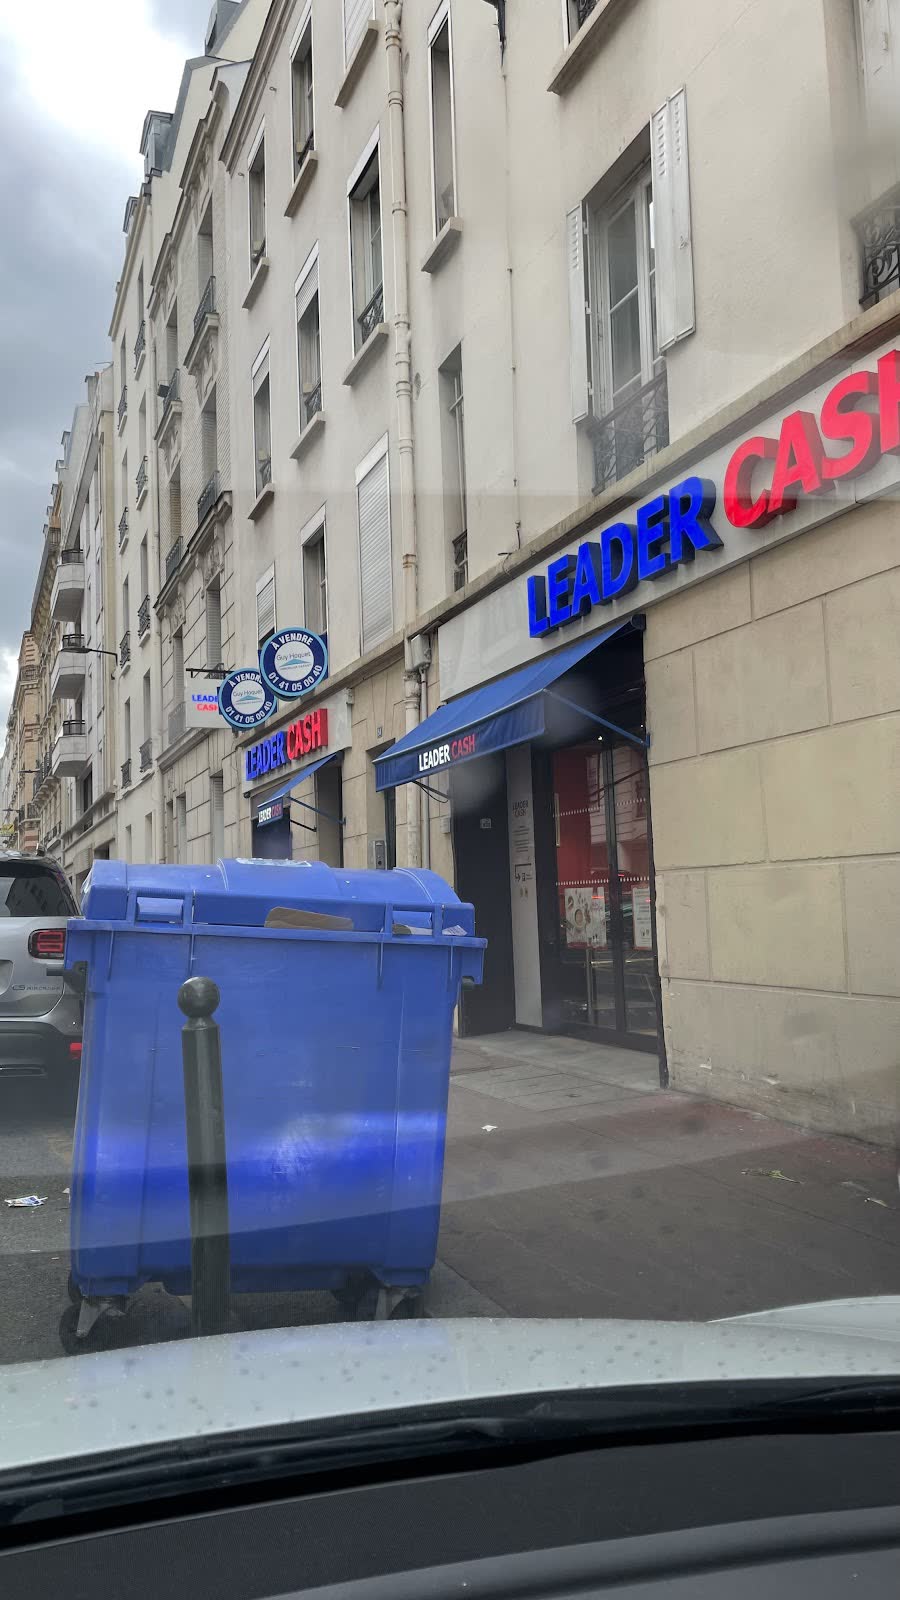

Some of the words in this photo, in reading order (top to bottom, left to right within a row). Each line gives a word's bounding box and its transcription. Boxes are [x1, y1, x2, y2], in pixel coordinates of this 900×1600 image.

[527, 476, 721, 638] LEADER
[278, 633, 314, 646] VENDRE
[268, 672, 279, 683] 01
[279, 681, 289, 691] 41
[292, 682, 302, 691] 05
[303, 676, 315, 687] 00
[312, 665, 322, 677] 40
[191, 694, 219, 702] LEADE
[225, 706, 235, 716] 01
[234, 714, 243, 723] 41
[245, 715, 254, 723] 05
[255, 710, 265, 720] 00
[263, 701, 273, 711] 40
[245, 730, 287, 781] LEADER
[287, 708, 326, 760] CASH
[418, 744, 451, 772] LEADER
[451, 733, 475, 759] CASH
